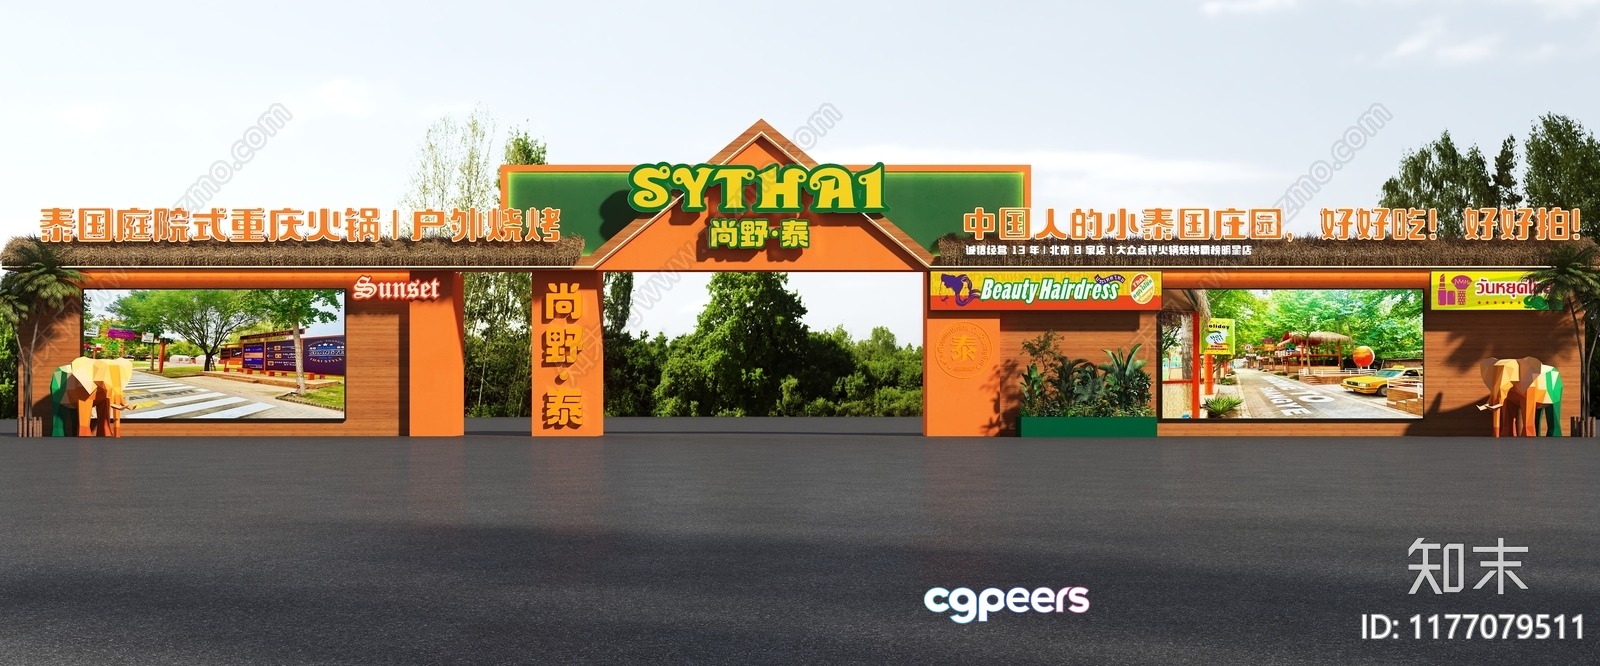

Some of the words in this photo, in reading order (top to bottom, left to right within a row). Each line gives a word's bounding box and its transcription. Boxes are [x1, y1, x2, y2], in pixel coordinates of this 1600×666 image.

[629, 163, 890, 212] SYTHAI
[39, 207, 381, 243] 泰国庭院式重庆火锅
[411, 207, 561, 242] 户外烧烤
[1012, 245, 1026, 255] 13
[1029, 245, 1040, 256] 年
[1049, 245, 1070, 256] 北京
[353, 275, 440, 300] Sunset
[980, 277, 1038, 304] Beauty
[1039, 277, 1120, 301] Hairdress
[949, 333, 977, 362] 泰
